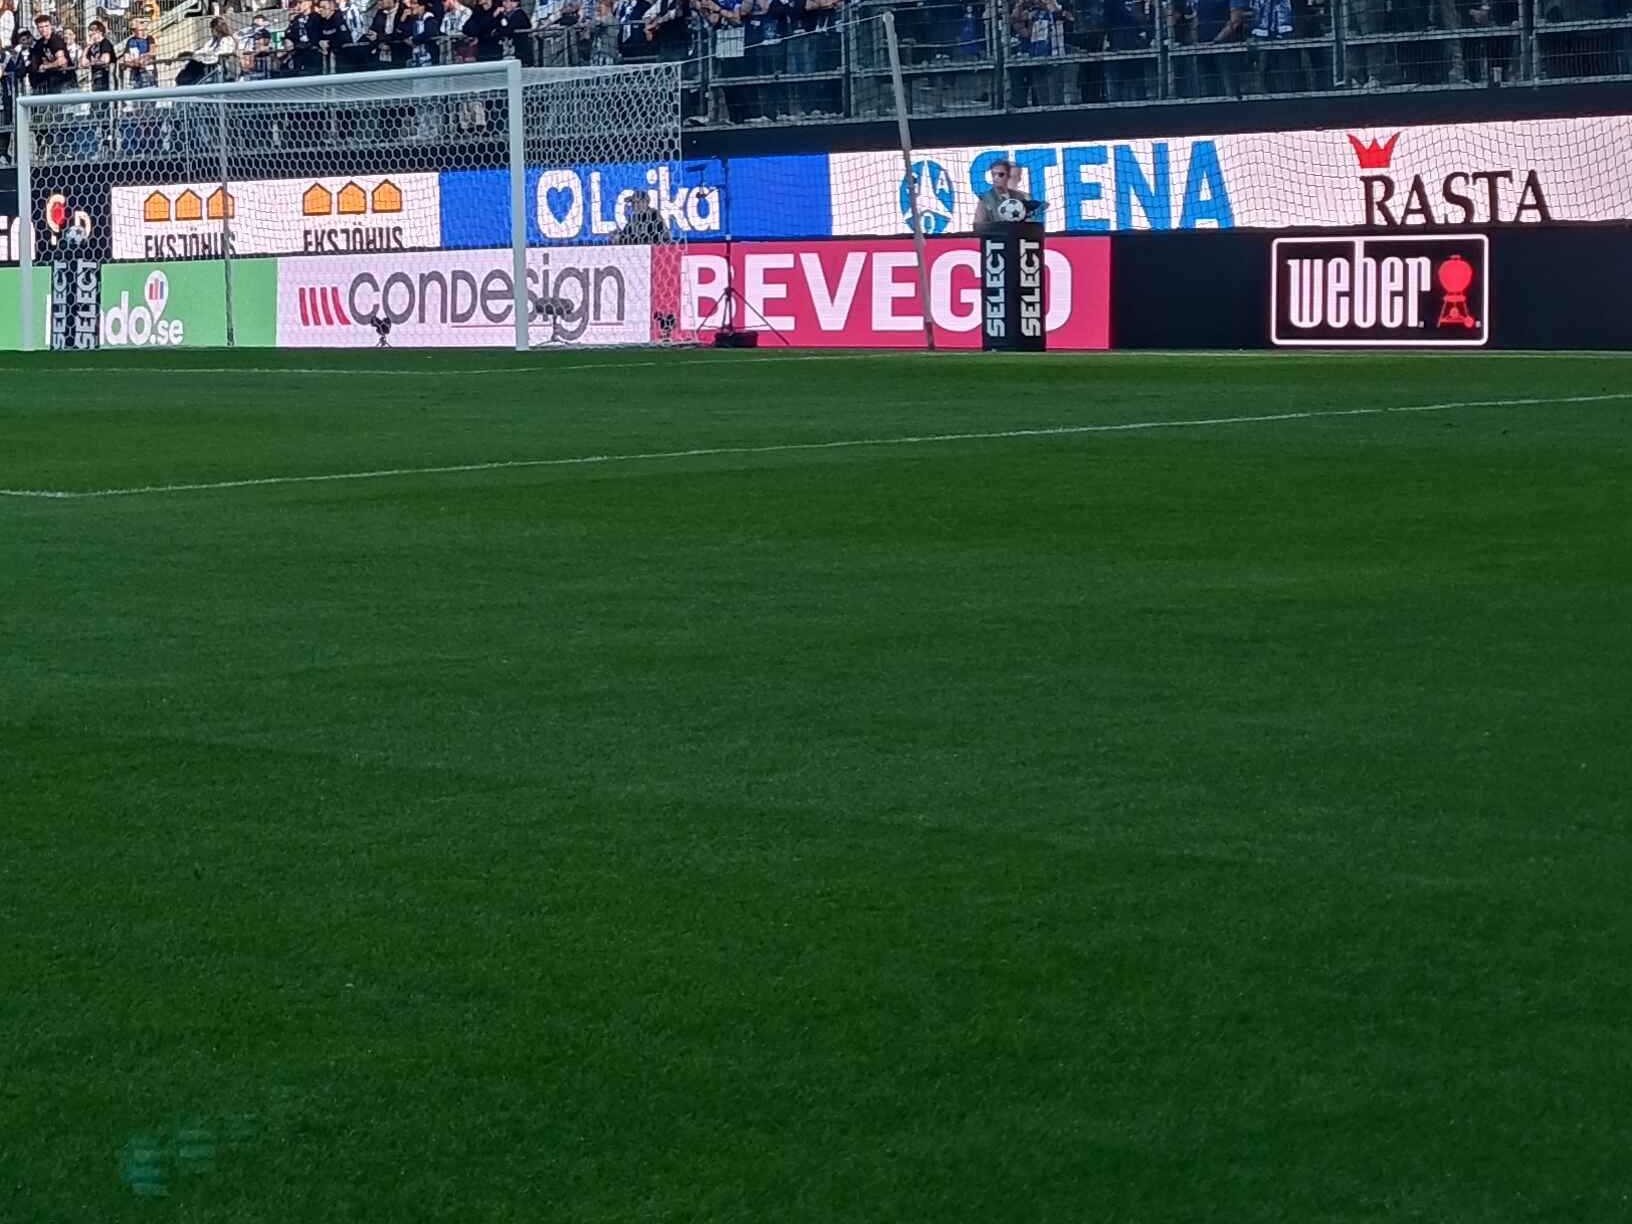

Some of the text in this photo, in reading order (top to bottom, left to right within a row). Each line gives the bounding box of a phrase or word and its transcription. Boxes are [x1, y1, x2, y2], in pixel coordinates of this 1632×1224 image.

[1360, 169, 1551, 227] RASTA
[53, 260, 66, 349] SELECT
[76, 259, 97, 349] SELECT
[986, 240, 1006, 337] SELECT
[1020, 239, 1042, 338] SELECT
